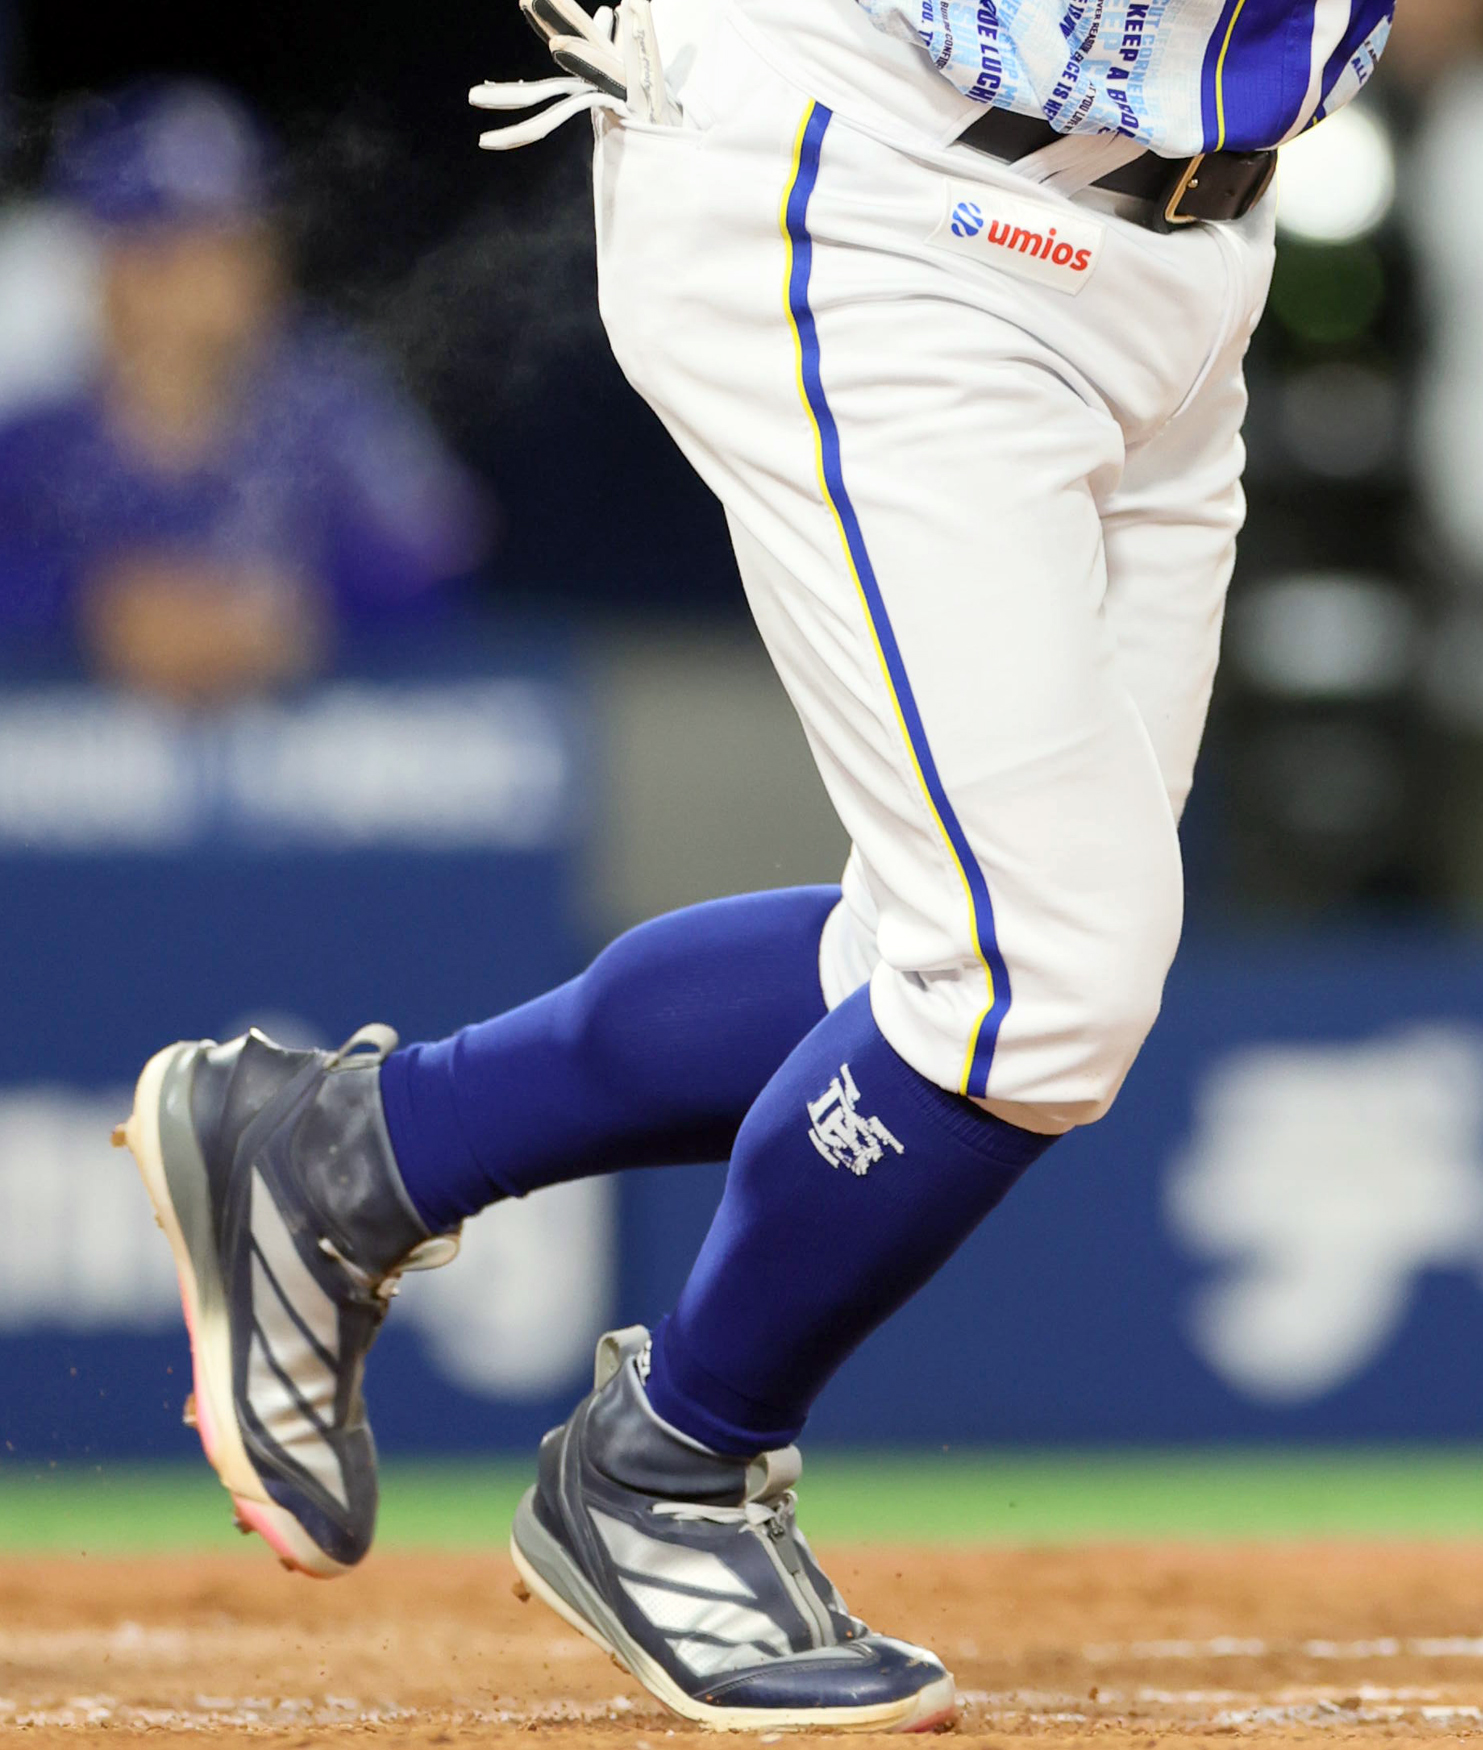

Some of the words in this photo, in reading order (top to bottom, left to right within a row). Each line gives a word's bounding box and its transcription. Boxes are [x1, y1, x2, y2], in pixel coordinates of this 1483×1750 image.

[1116, 5, 1147, 60] KEEP
[964, 43, 1000, 103] LUCH
[1105, 66, 1129, 79] A
[1350, 57, 1367, 84] ALL
[1050, 81, 1070, 100] IS
[1078, 94, 1094, 111] YOU
[987, 219, 1092, 271] umios
